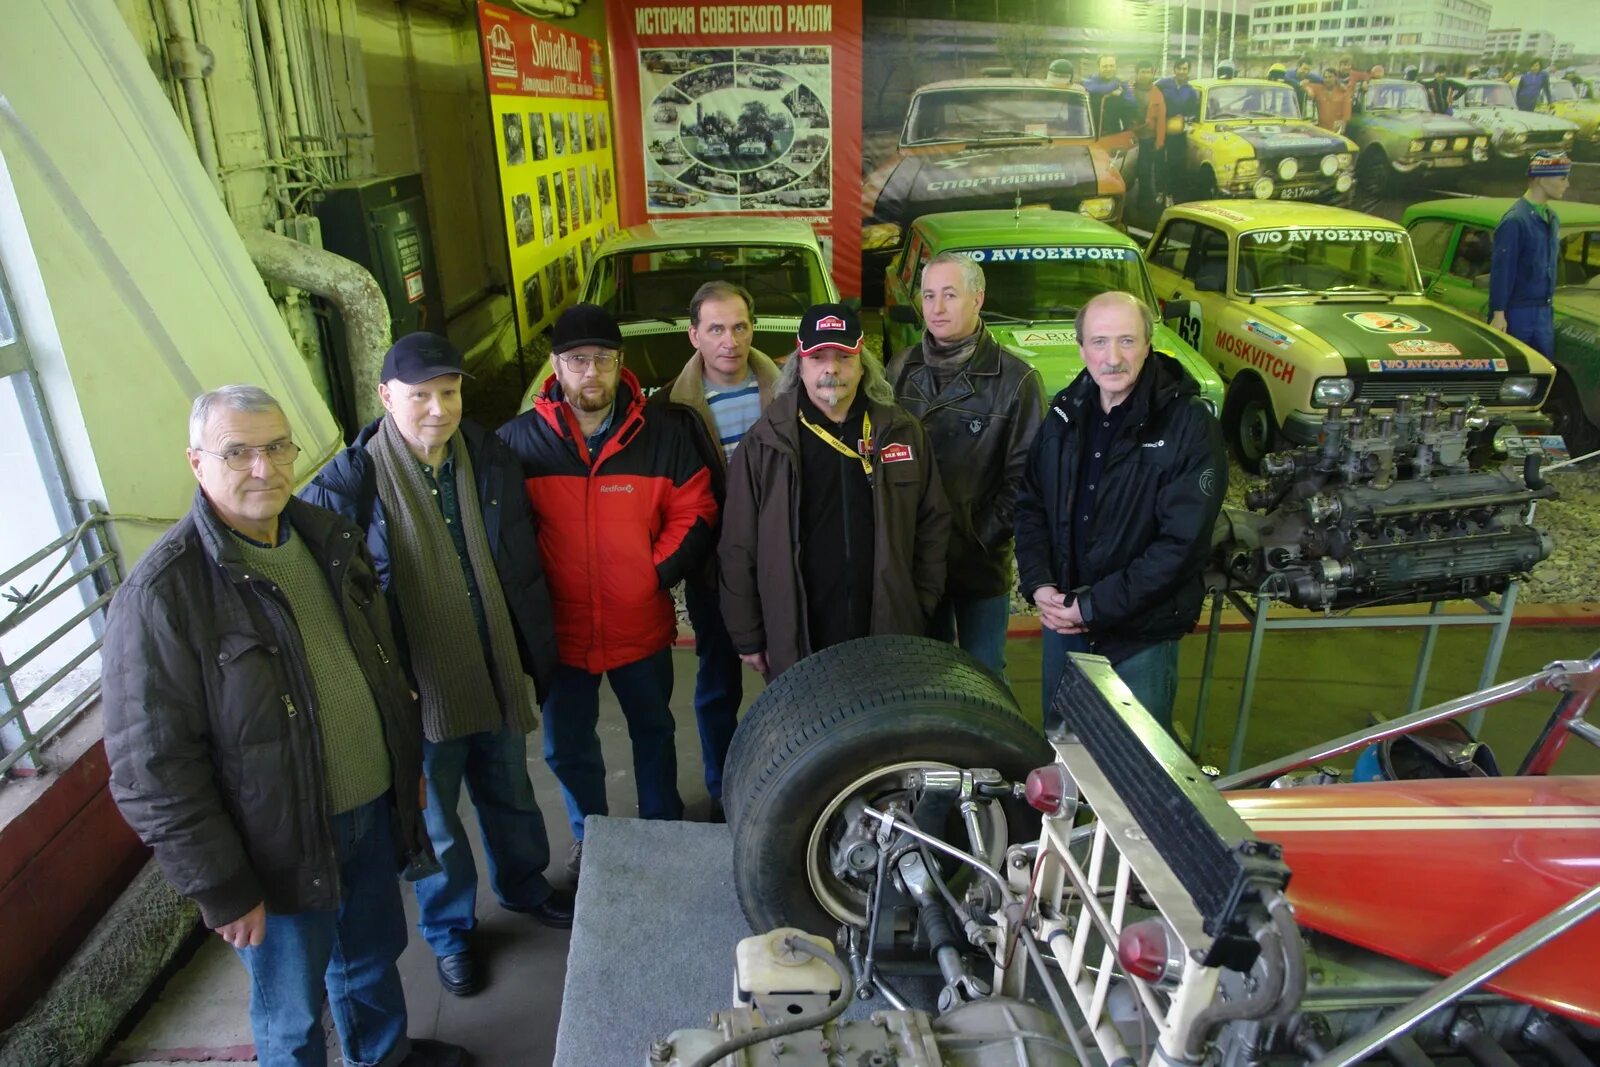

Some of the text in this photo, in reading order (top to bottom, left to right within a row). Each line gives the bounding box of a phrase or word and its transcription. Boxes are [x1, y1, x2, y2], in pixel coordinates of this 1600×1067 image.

[636, 5, 832, 34] ИСТОРИЯ СОВЕТСКОГО РАЛЛИ
[531, 24, 581, 82] SovietRally
[1253, 230, 1403, 244] V/O AVTOEXPORT
[991, 248, 1124, 261] AVTOEXPORT
[1179, 316, 1201, 351] 63
[1215, 329, 1296, 385] MOSKVITCH
[1407, 360, 1490, 369] AVTOEXPORT
